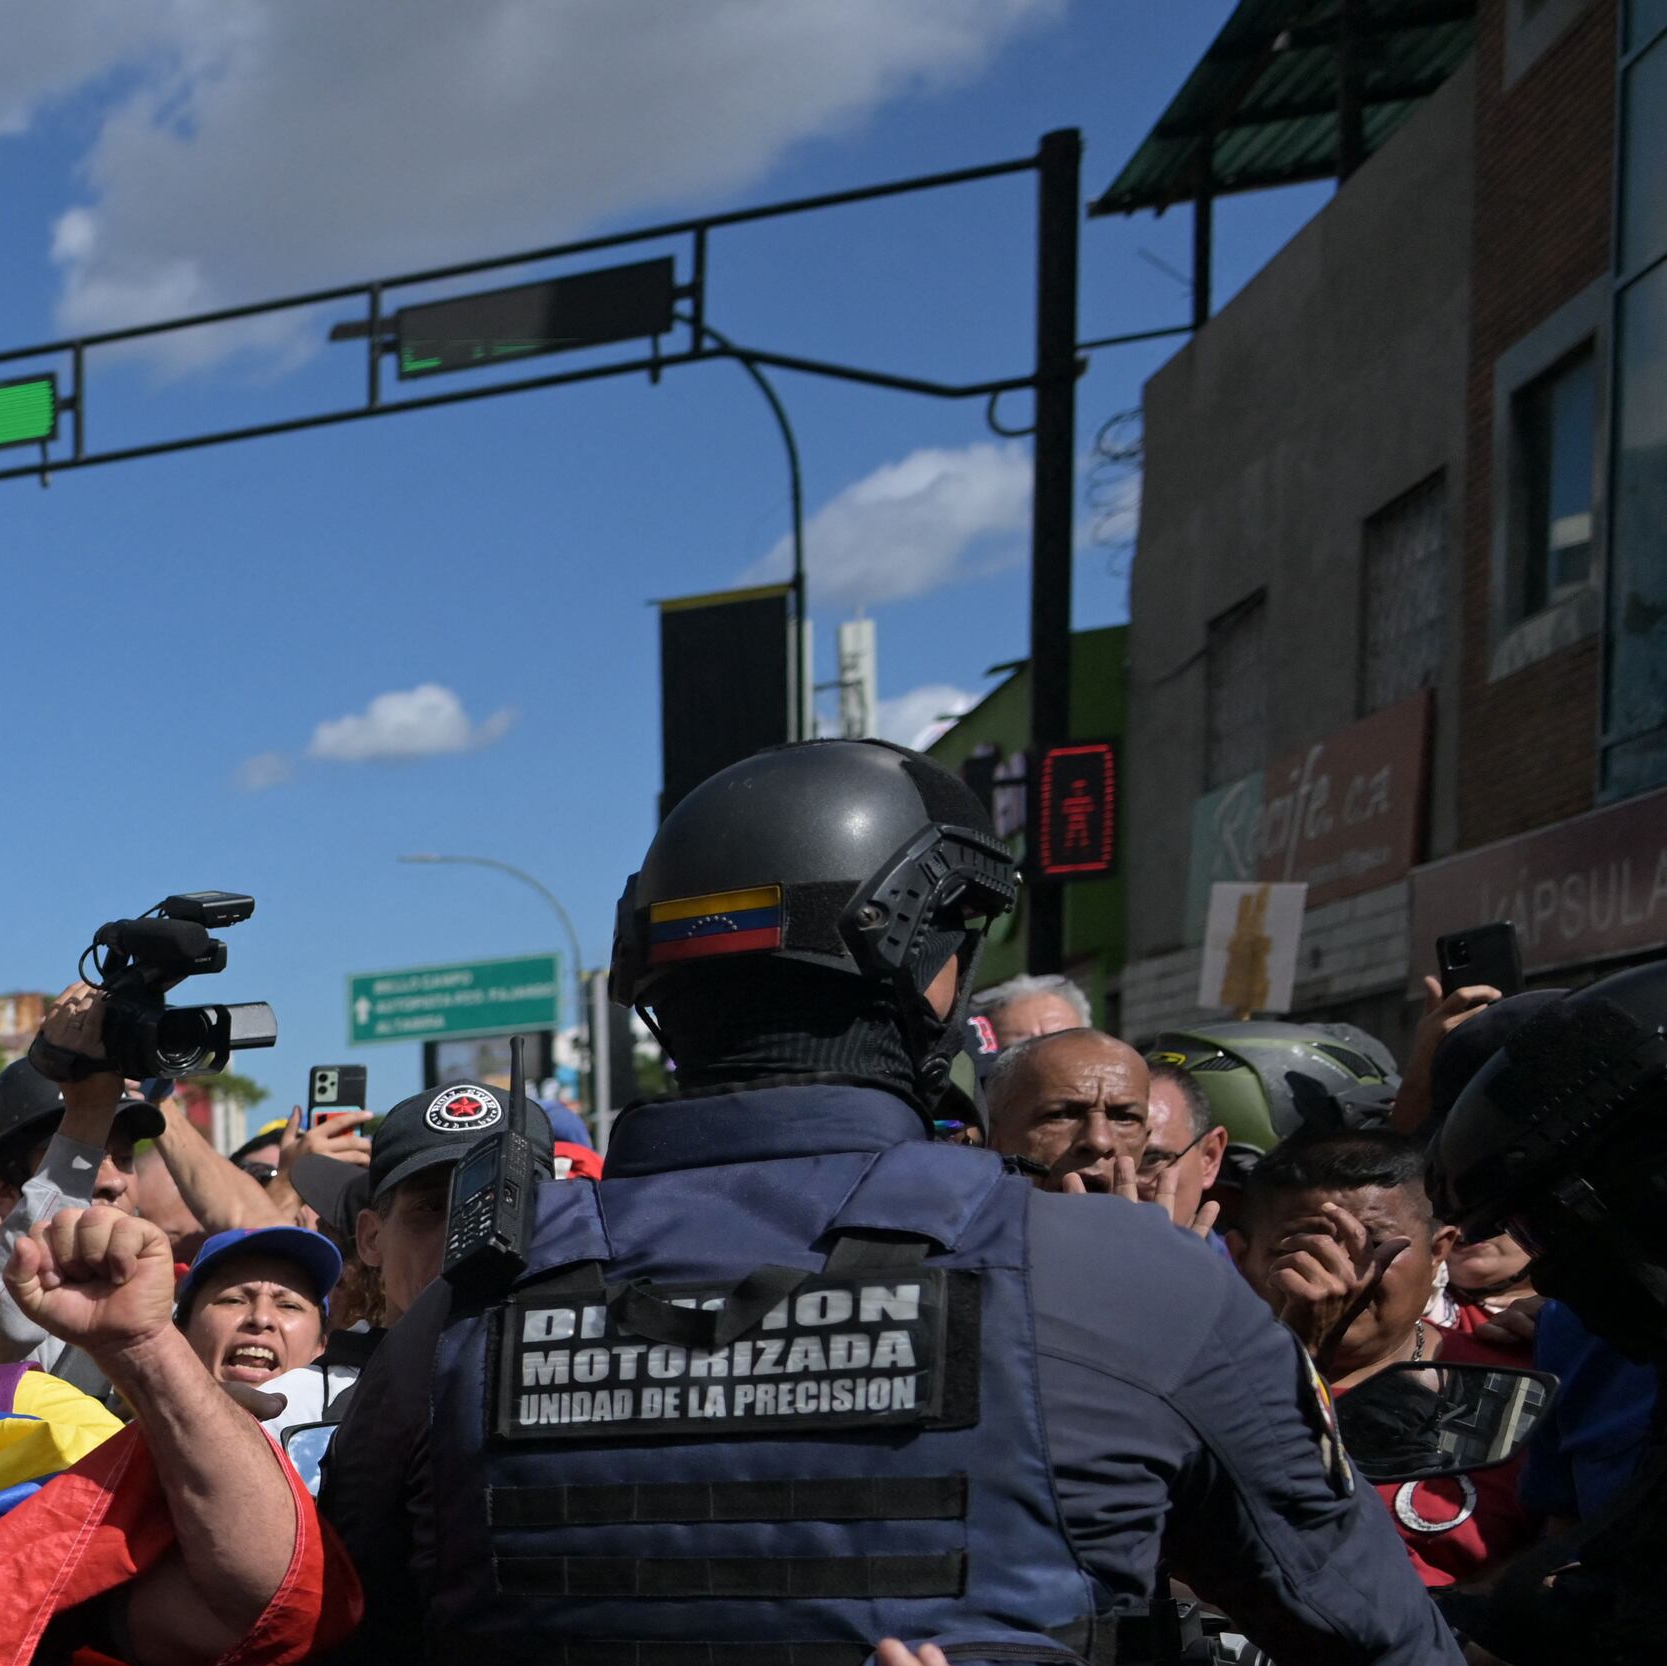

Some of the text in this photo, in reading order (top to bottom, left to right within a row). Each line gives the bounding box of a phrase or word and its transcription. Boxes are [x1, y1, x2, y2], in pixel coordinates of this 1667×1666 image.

[521, 1330, 917, 1387] MOTORIZADA
[519, 1376, 917, 1426] UNIDAD DE LA PRECISION
